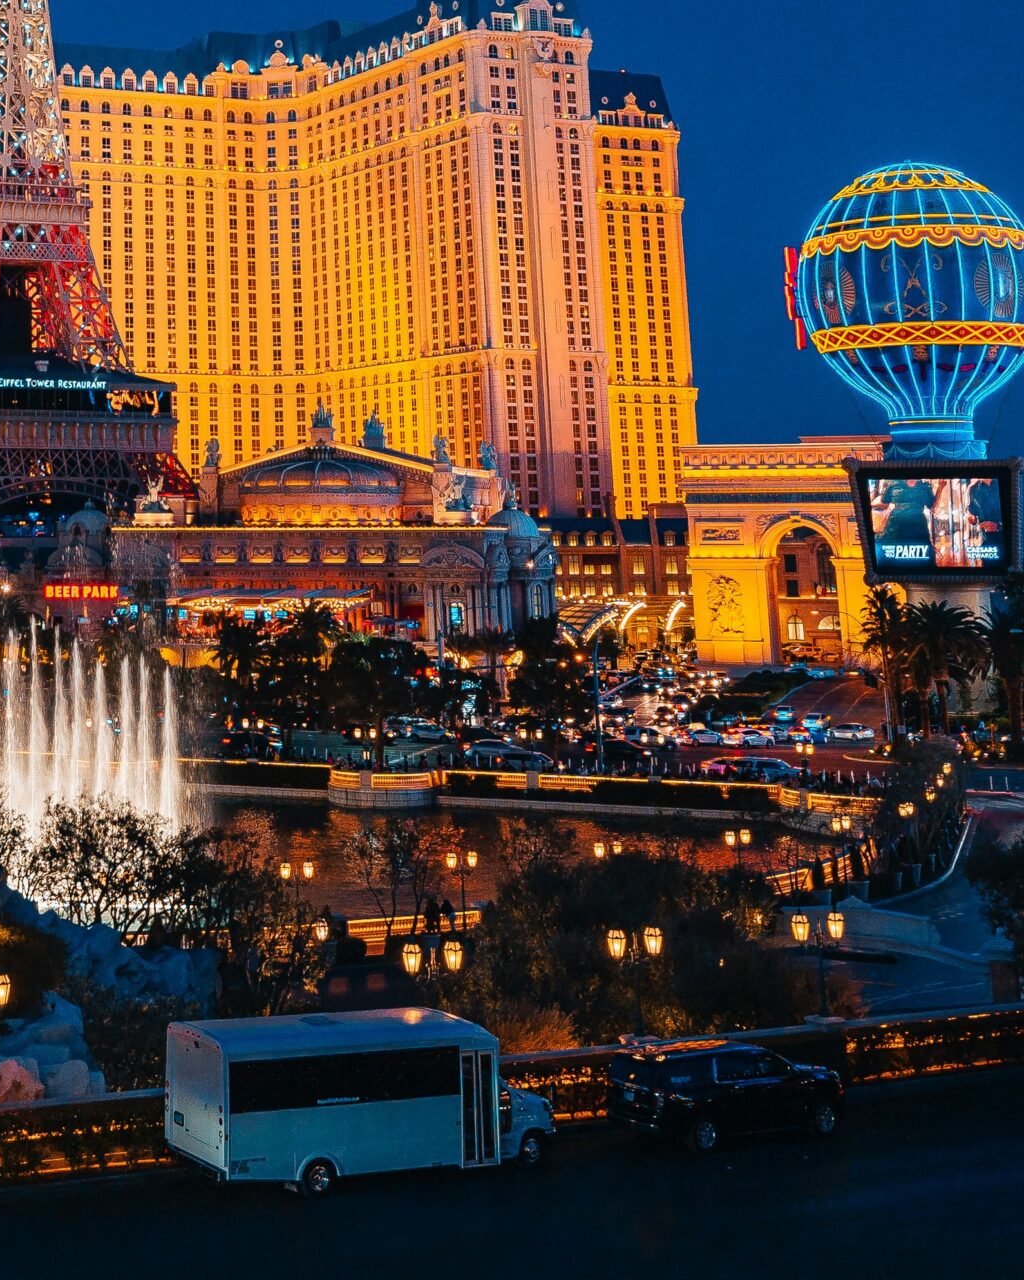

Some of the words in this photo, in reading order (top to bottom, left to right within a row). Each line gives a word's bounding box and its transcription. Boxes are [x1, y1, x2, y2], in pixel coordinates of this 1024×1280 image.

[25, 377, 55, 388] TOWER
[57, 379, 107, 390] RESTAURANT
[895, 544, 929, 558] PARTY
[45, 585, 80, 598] BEER
[82, 585, 118, 598] PARK
